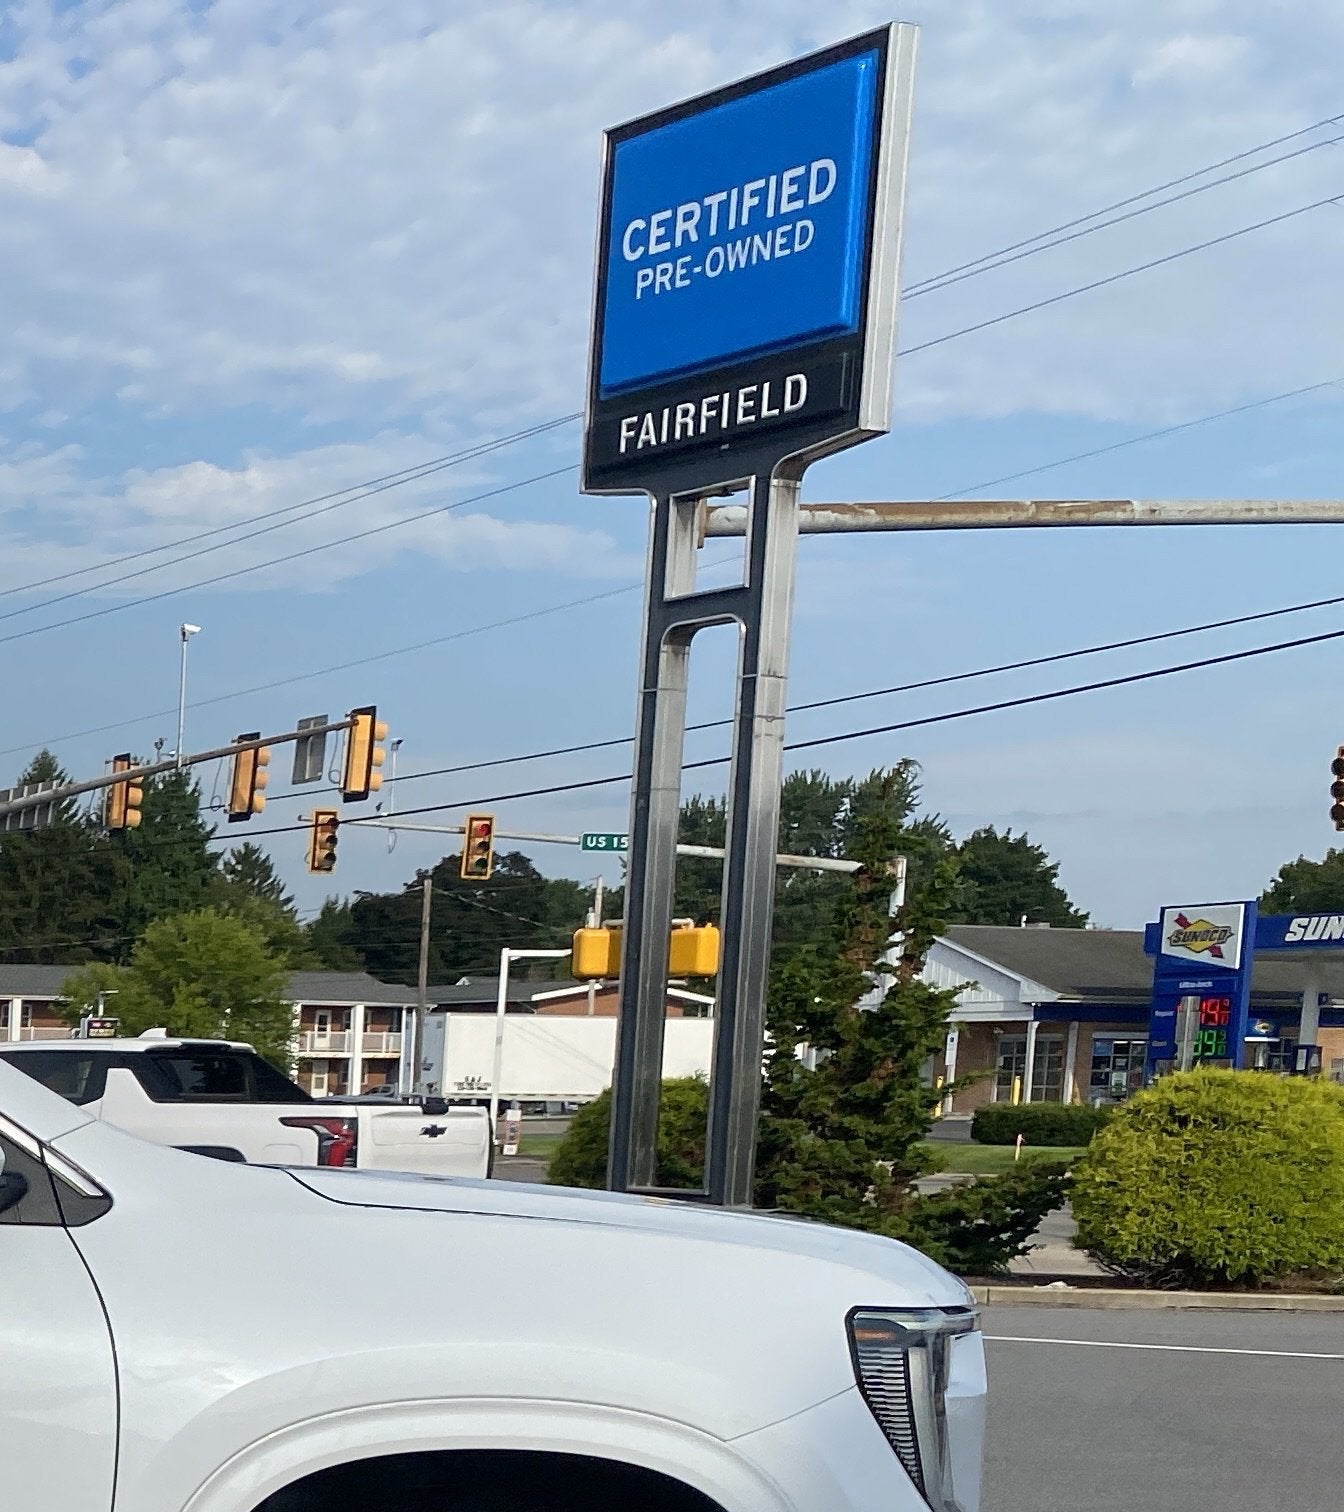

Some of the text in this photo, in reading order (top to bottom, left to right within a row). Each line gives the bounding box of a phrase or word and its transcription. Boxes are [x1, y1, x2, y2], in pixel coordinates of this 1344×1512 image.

[622, 158, 838, 261] CERTIFIED
[635, 220, 816, 300] PRE-OWNED
[619, 373, 808, 454] FAIRFIELD
[586, 836, 629, 849] US 15
[1171, 927, 1229, 944] SUNOCO
